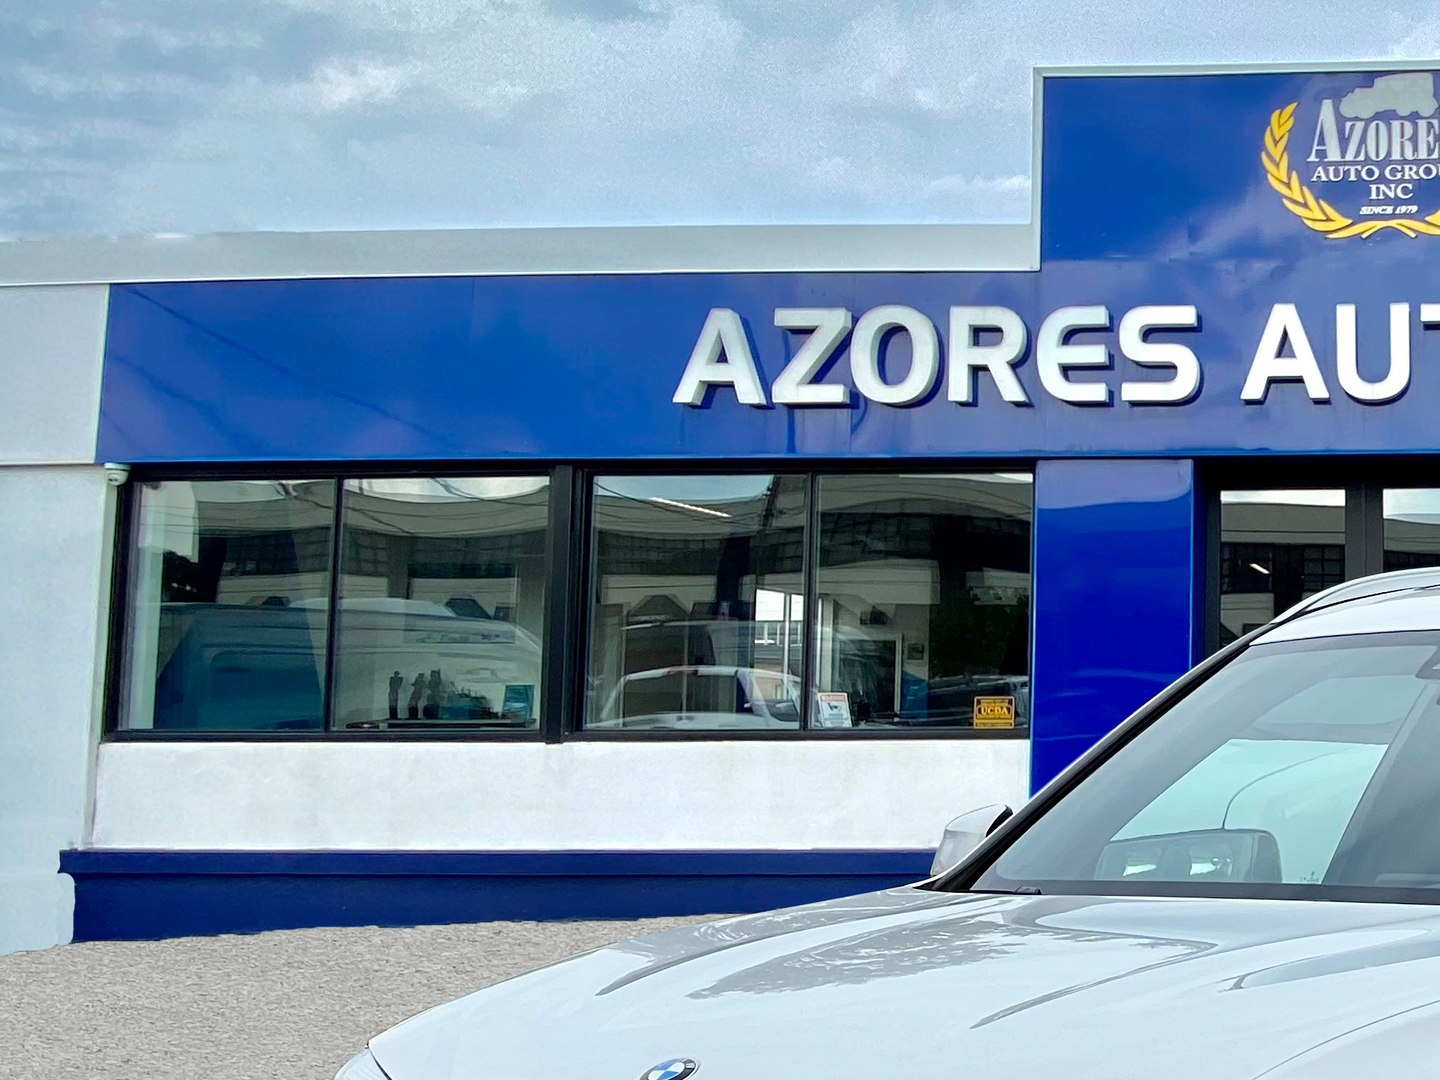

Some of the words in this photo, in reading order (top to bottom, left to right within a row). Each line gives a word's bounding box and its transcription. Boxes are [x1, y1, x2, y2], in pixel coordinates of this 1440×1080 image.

[1311, 164, 1380, 182] AUTO
[1369, 183, 1414, 200] INC
[1359, 205, 1394, 215] SINCE
[1394, 205, 1418, 214] 1979
[672, 303, 1200, 405] AZORES
[981, 706, 1008, 715] UCDA
